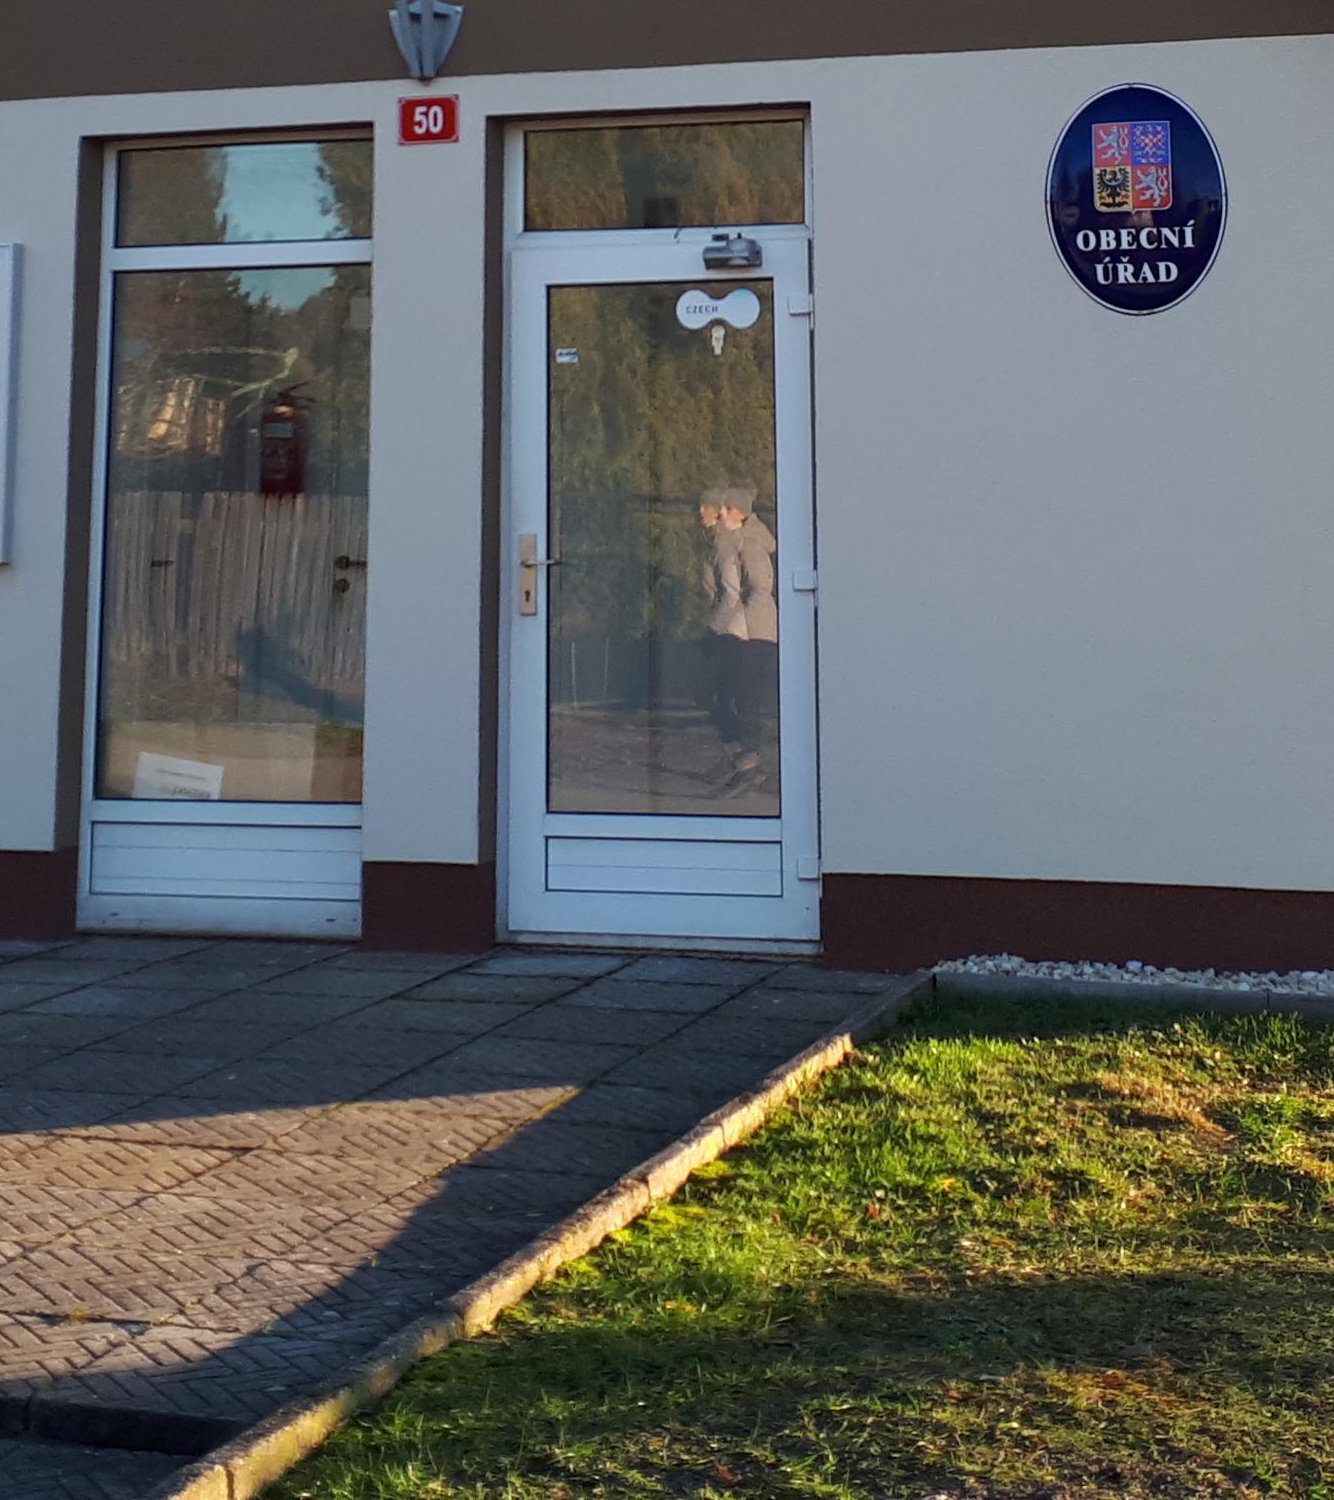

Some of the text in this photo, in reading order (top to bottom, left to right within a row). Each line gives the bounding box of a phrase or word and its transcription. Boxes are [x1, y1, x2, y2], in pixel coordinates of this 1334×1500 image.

[413, 105, 444, 135] 50
[1076, 220, 1196, 251] OBECNÍ
[1094, 256, 1179, 285] ÚŘAD
[685, 304, 719, 314] CZECH
